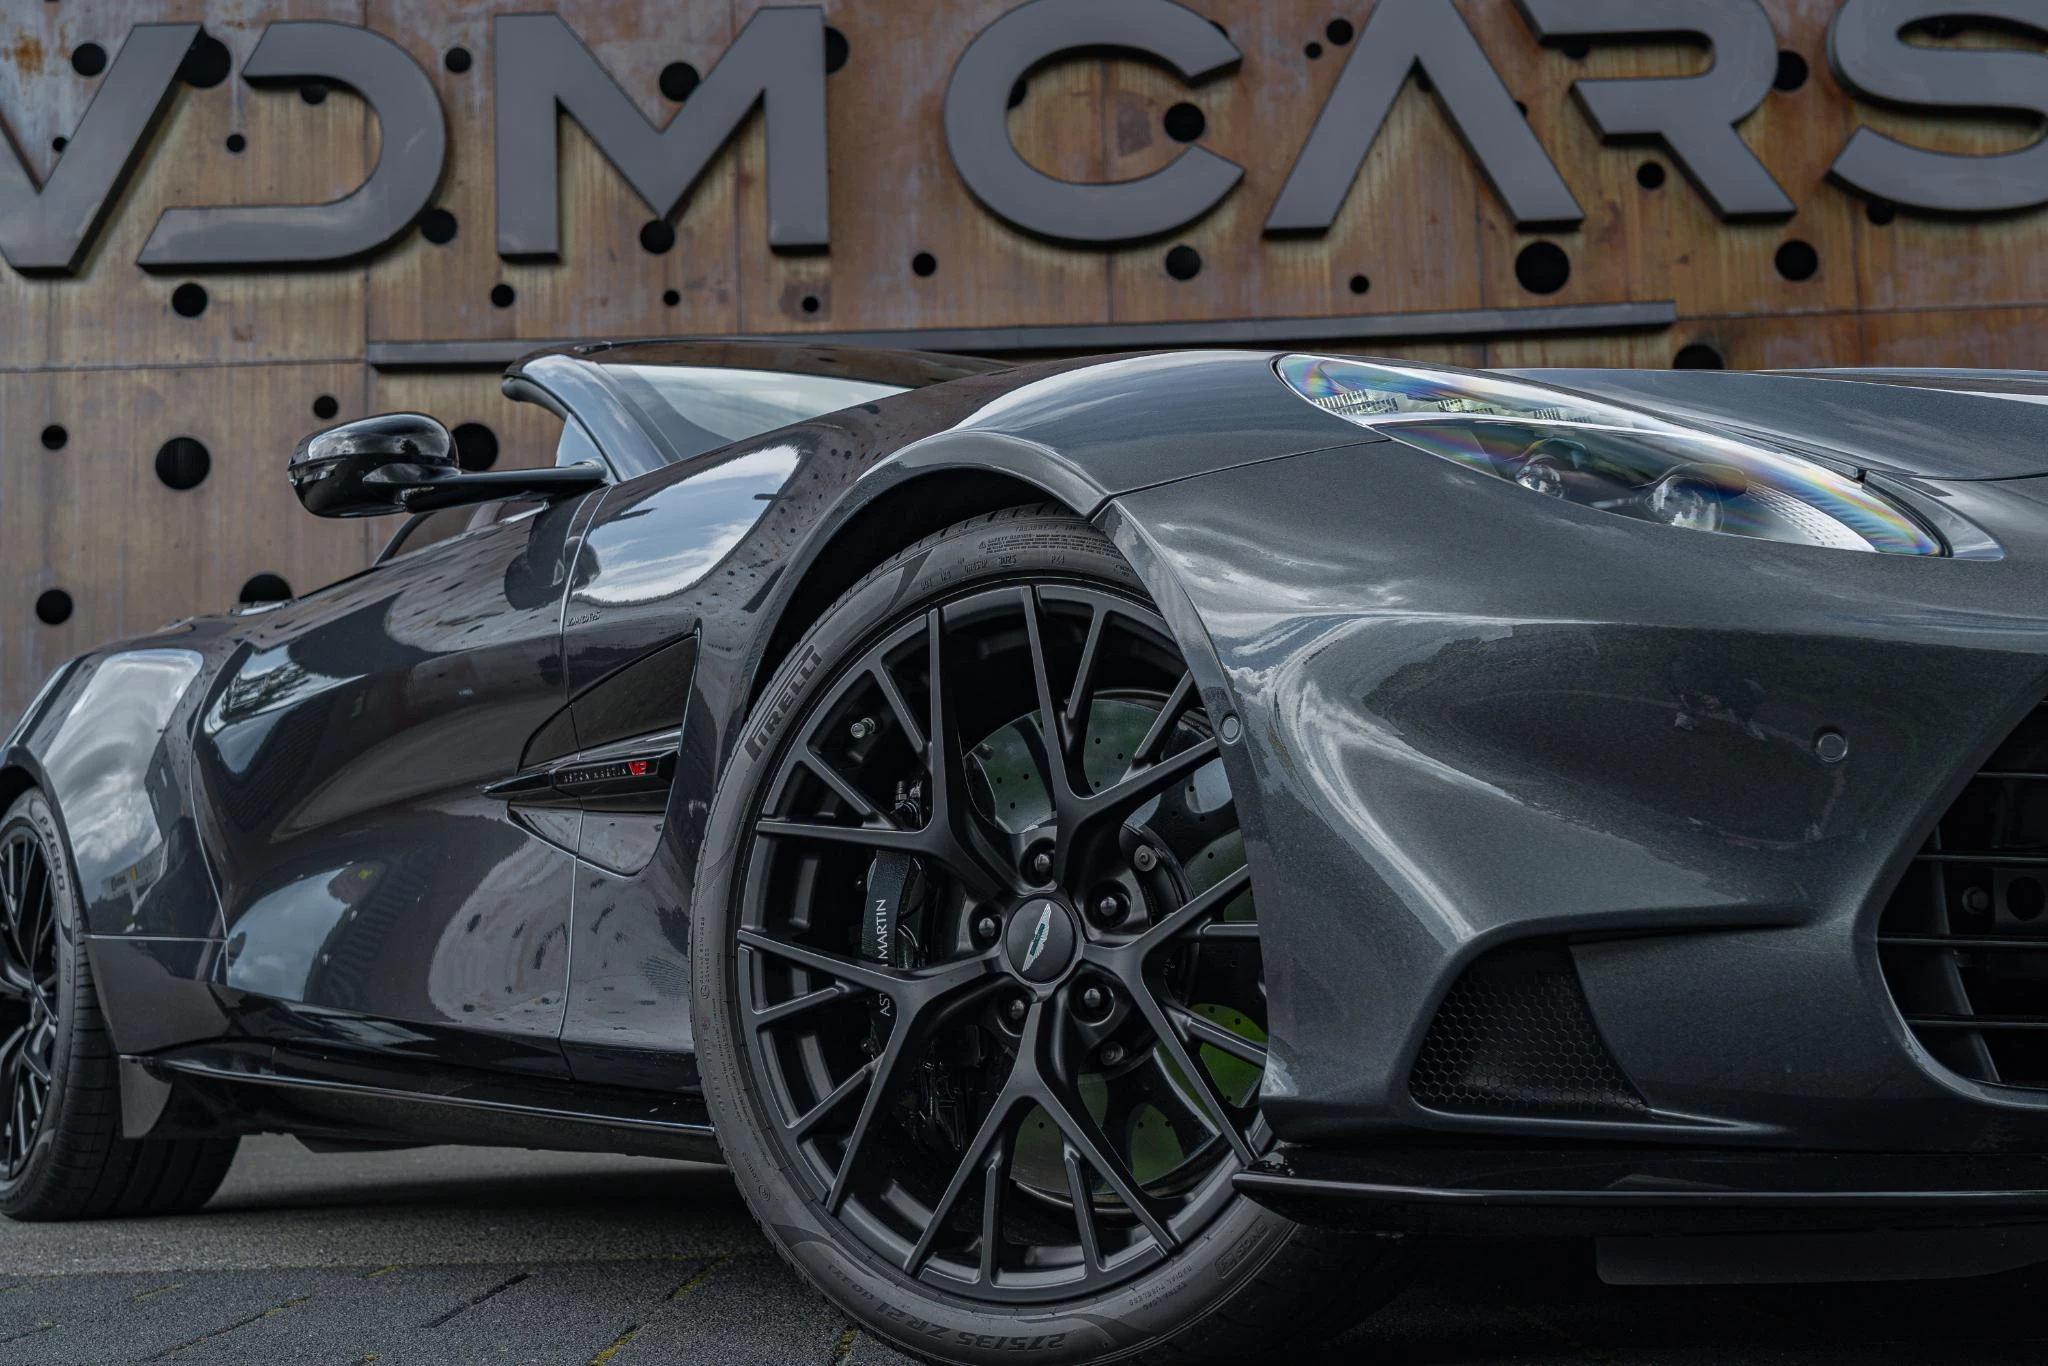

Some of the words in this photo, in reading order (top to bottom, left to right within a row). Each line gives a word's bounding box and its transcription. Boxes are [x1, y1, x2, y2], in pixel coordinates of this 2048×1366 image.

[0, 5, 830, 276] VDM
[943, 0, 2048, 243] CARS
[745, 644, 823, 762] PIRELLI
[39, 815, 49, 826] P
[45, 828, 65, 891] ZERO
[876, 899, 889, 959] MARTIN
[955, 1330, 1066, 1353] 275/35
